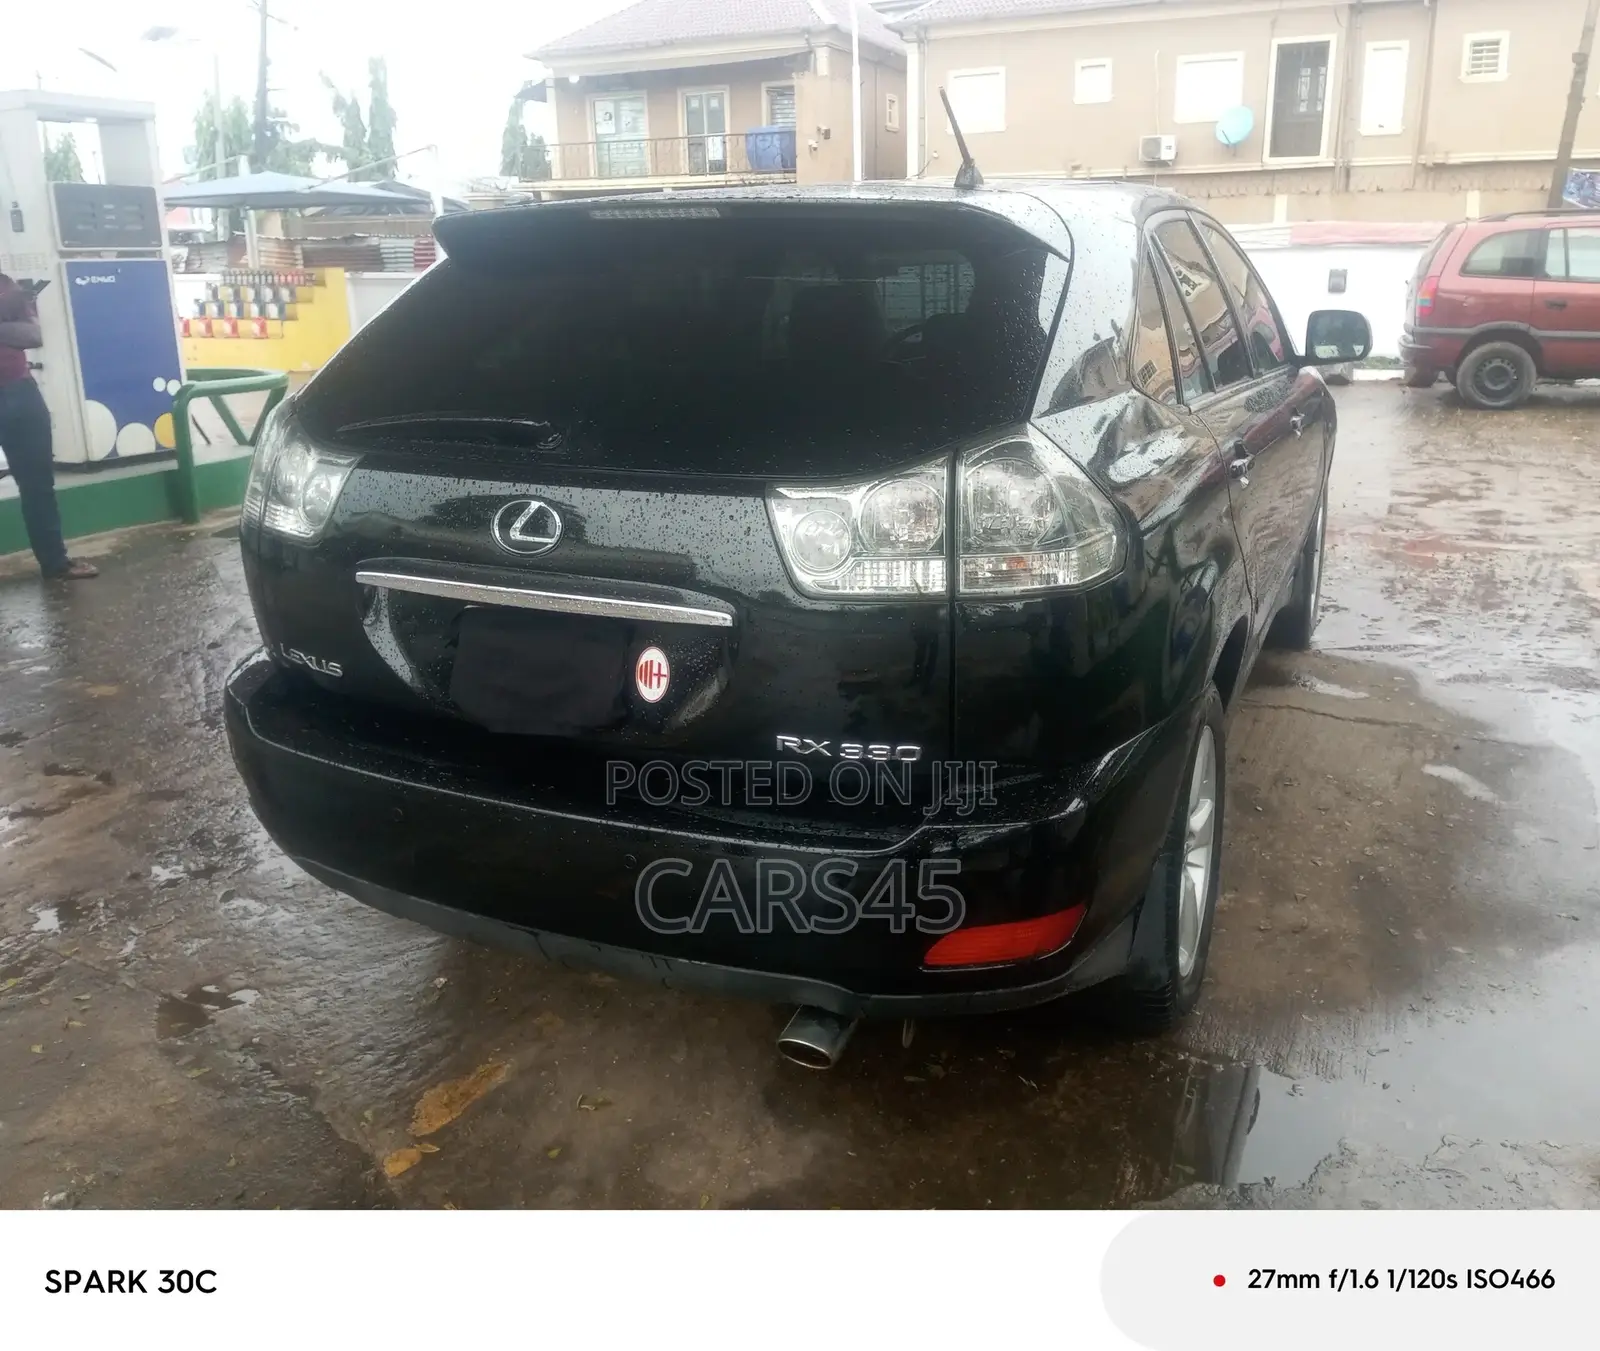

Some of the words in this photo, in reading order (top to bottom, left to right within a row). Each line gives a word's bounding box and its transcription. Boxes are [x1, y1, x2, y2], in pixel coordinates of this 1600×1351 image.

[279, 642, 343, 677] LEXUS
[776, 735, 832, 757] RX
[839, 743, 922, 761] 330
